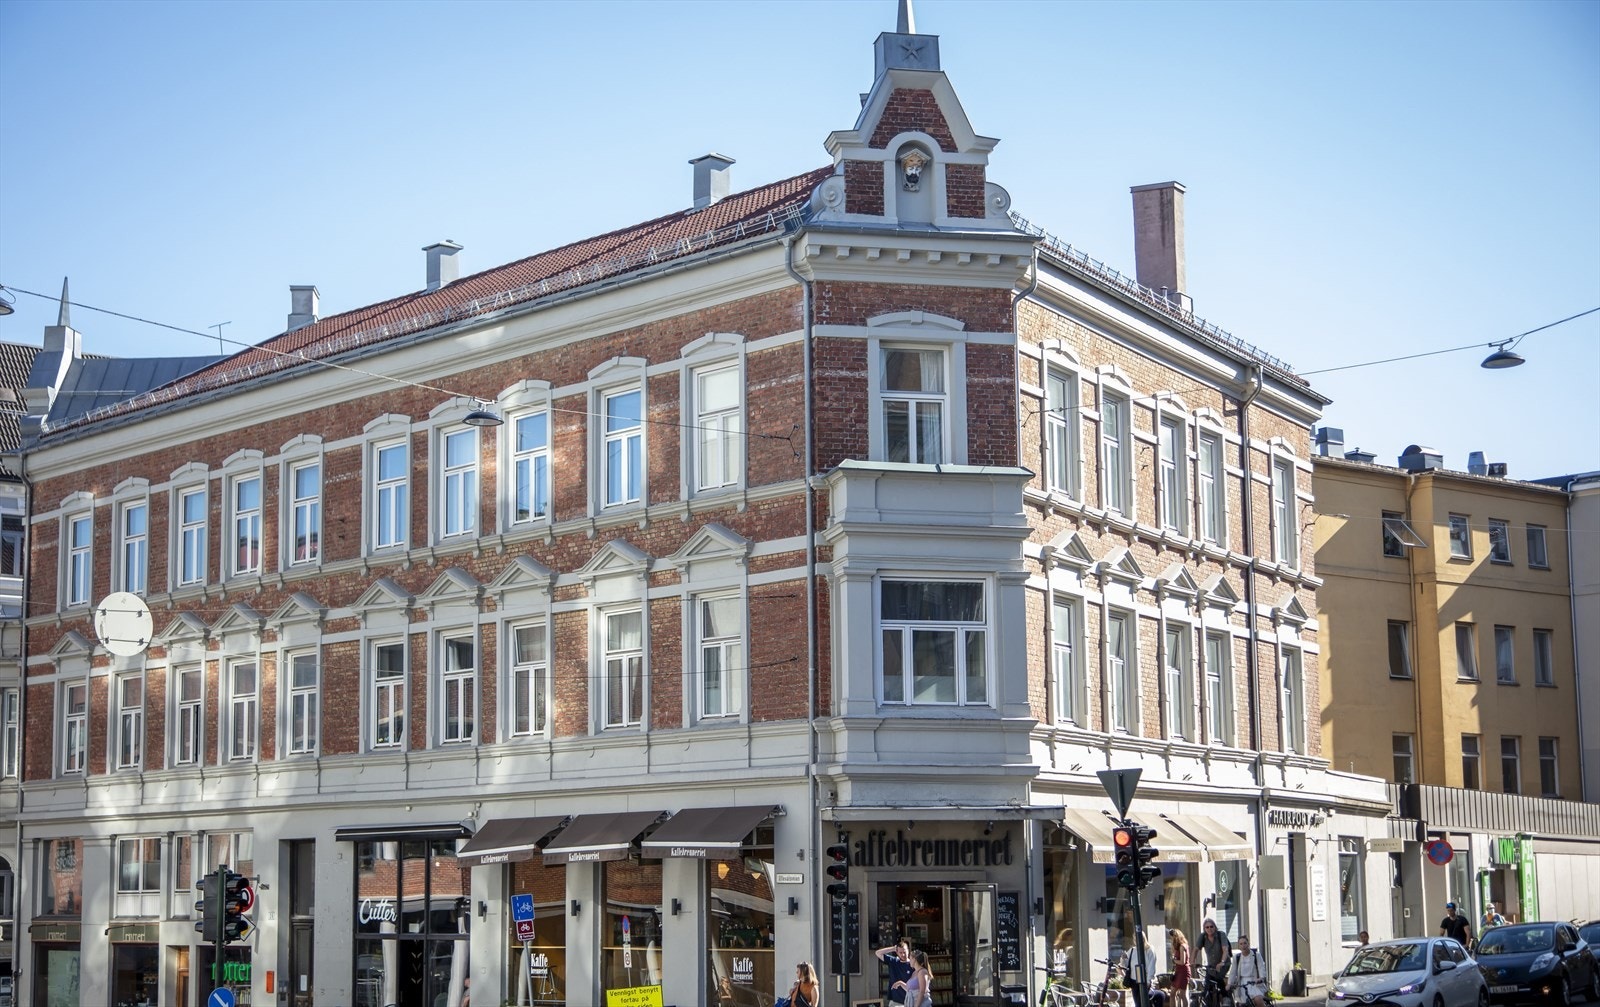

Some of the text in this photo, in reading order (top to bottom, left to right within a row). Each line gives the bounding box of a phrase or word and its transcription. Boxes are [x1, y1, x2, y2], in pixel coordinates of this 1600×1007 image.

[1269, 810, 1309, 826] HAIRPORT
[359, 898, 397, 924] Cutter
[530, 953, 549, 967] Kaffe
[733, 957, 753, 972] Kaffe
[609, 986, 659, 997] Vennligst benytt
[641, 995, 650, 1003] på
